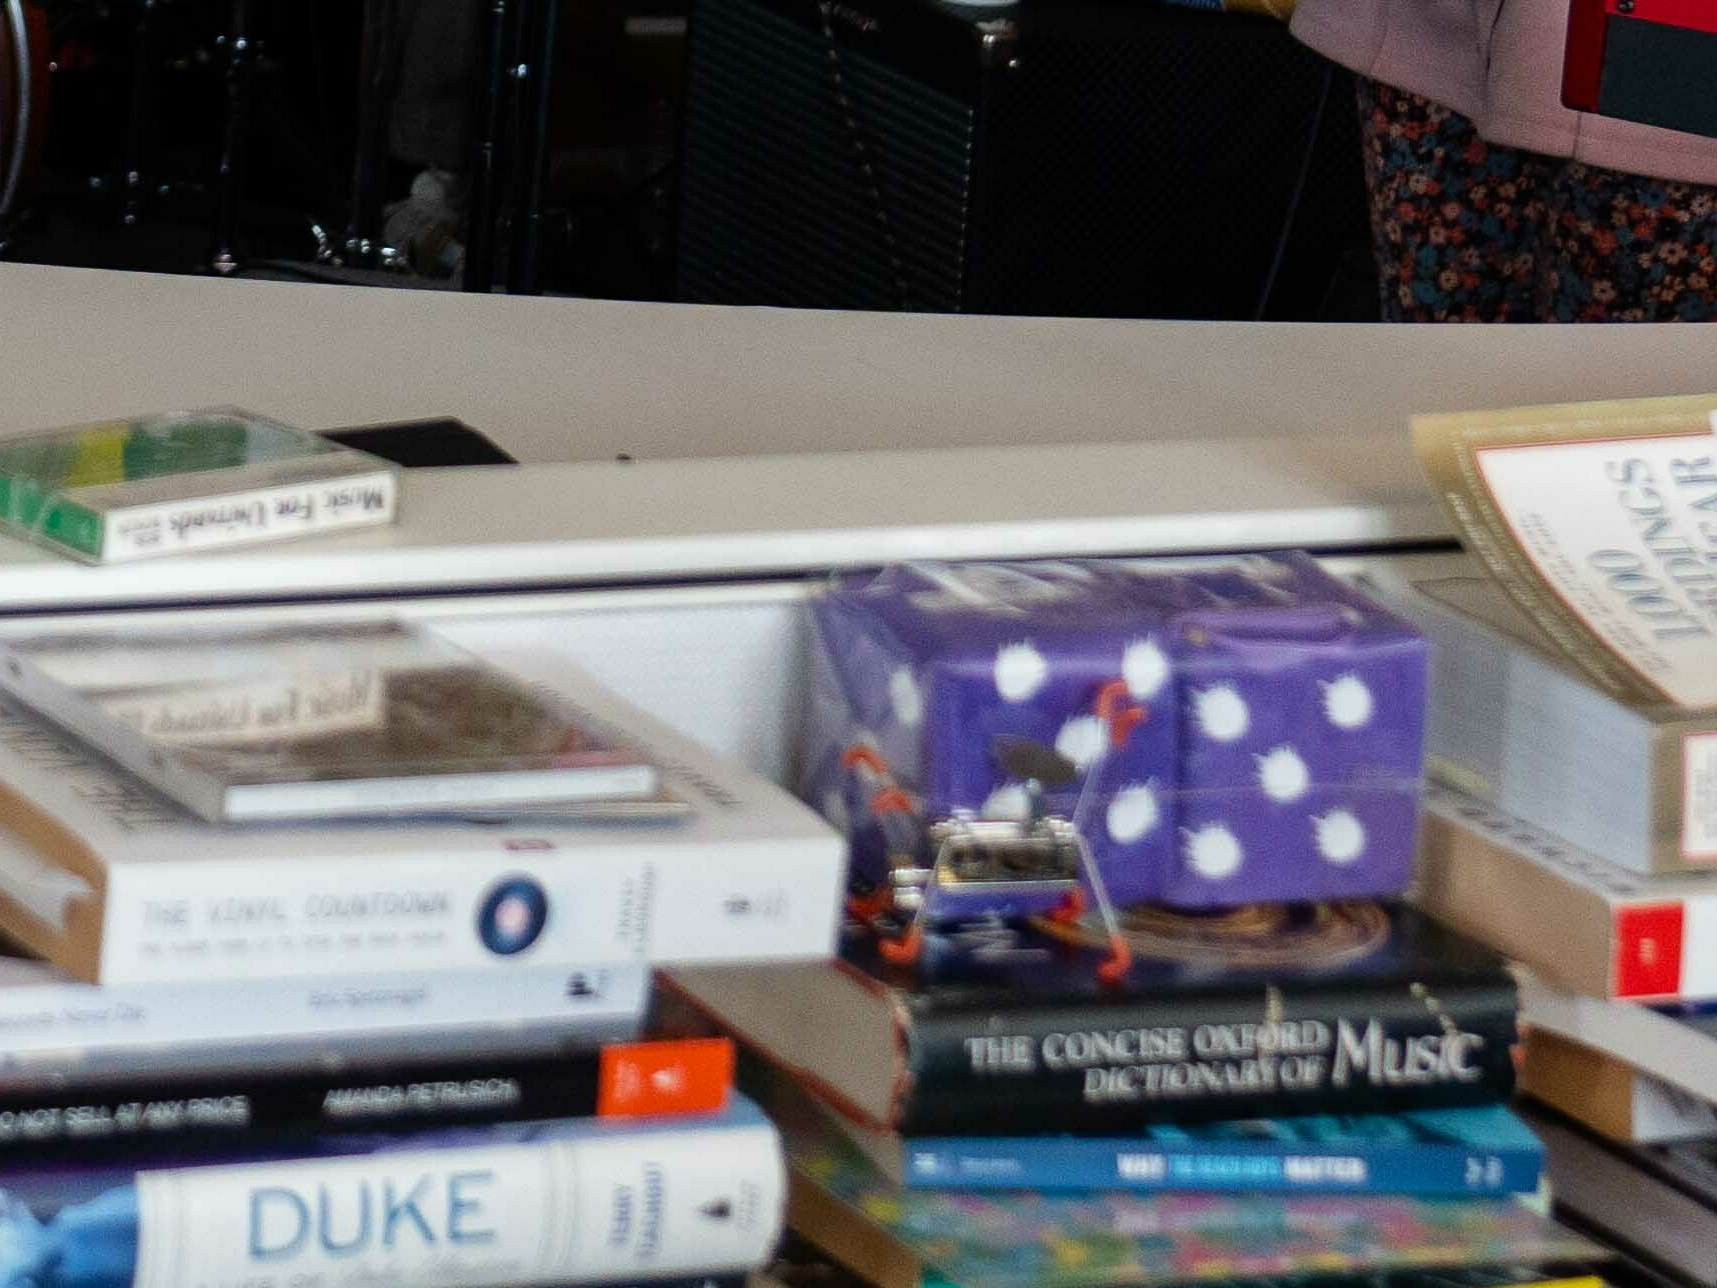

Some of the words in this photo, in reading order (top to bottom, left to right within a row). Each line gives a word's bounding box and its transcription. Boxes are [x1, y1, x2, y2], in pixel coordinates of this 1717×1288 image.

[141, 896, 189, 925] THE
[207, 894, 286, 924] VINYL
[303, 889, 450, 919] COUNTDOWN
[967, 1034, 1036, 1069] THE
[1040, 1026, 1186, 1068] CONCISE
[1193, 1019, 1332, 1058] OXFORD
[323, 1083, 403, 1116] AMANDA
[406, 1077, 520, 1109] PETRUSICH
[1083, 1059, 1276, 1102] DICTIONARY
[11, 1108, 59, 1138] NOT
[64, 1104, 113, 1135] SELL
[116, 1103, 138, 1131] AT
[144, 1100, 184, 1130] ANY
[187, 1094, 251, 1126] PRICE
[248, 1168, 499, 1262] DUKE
